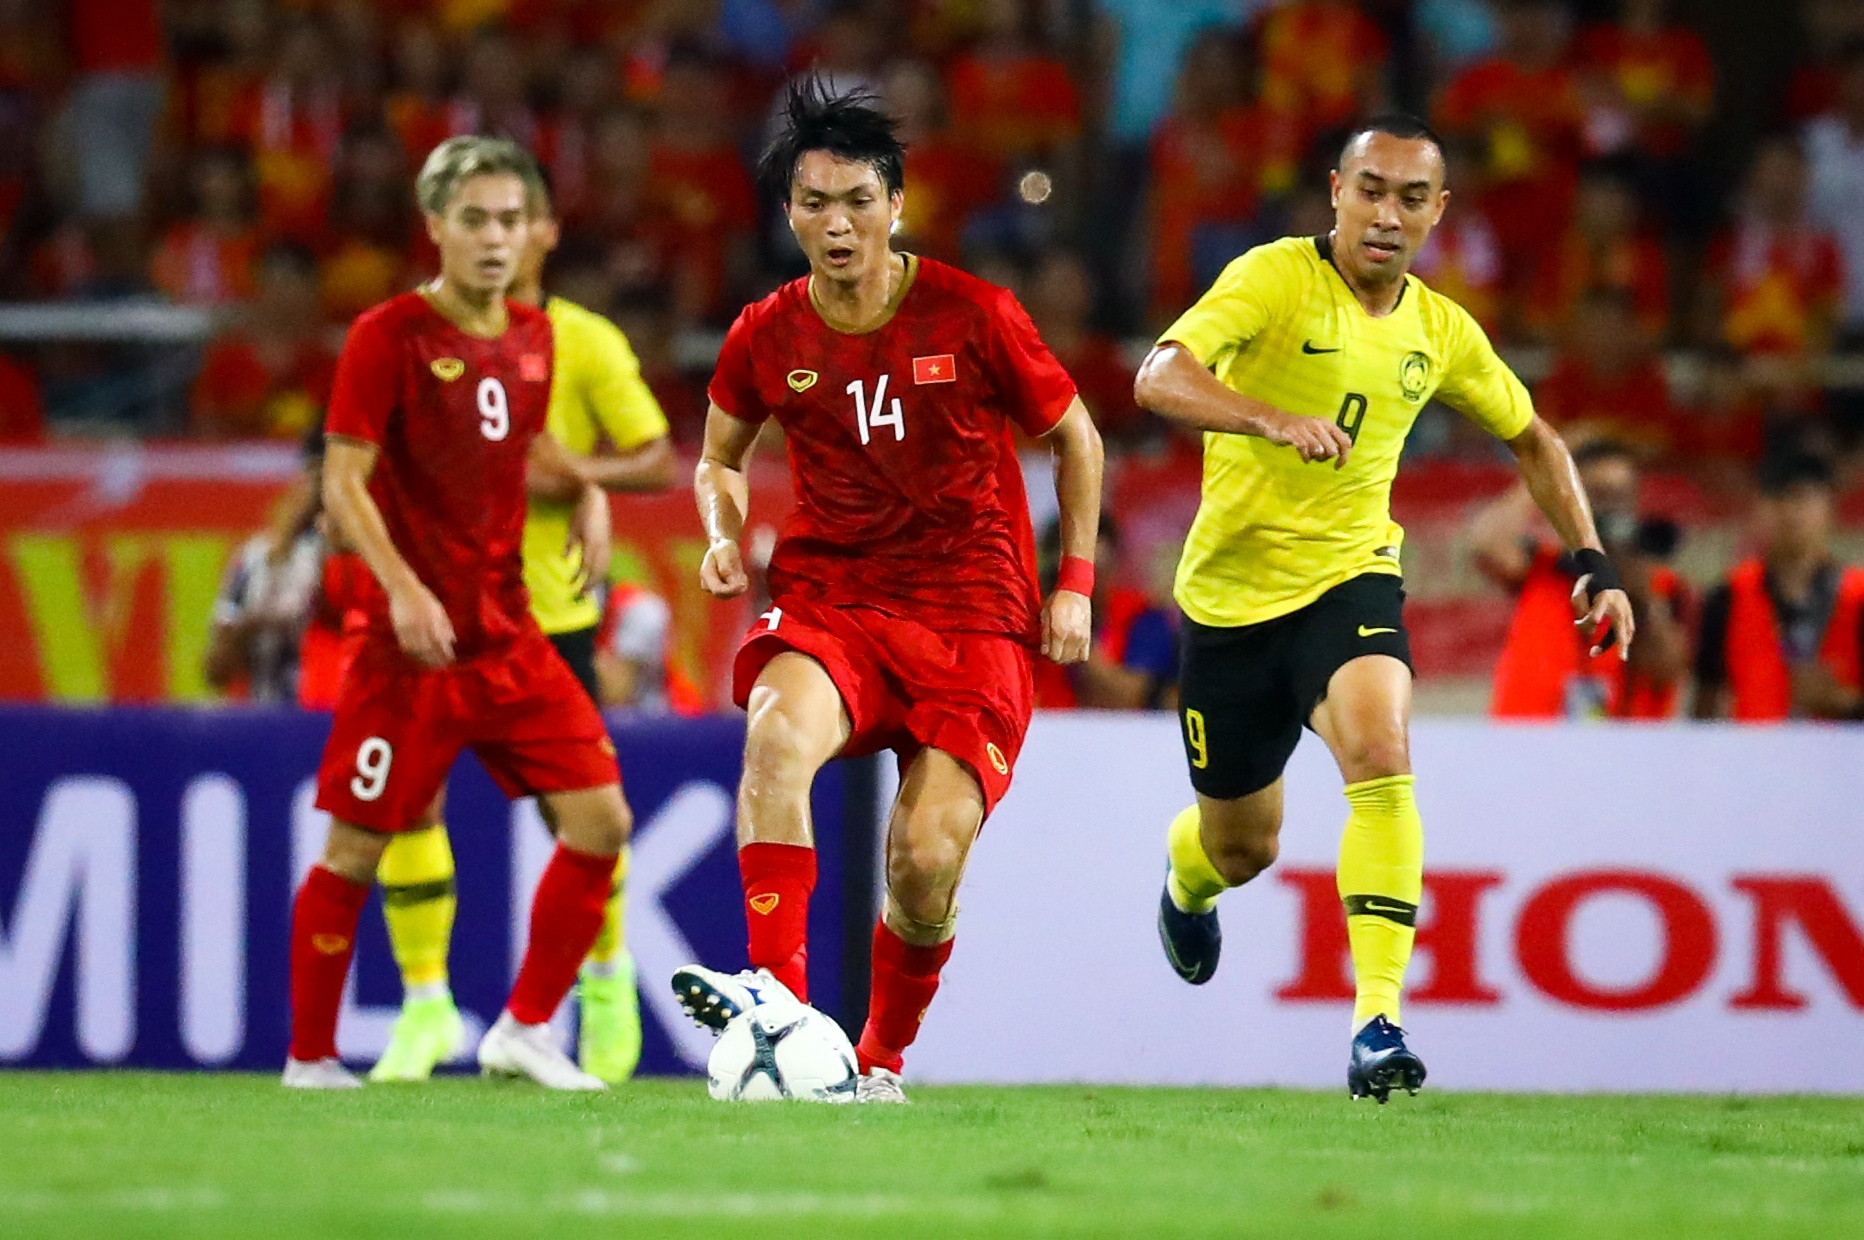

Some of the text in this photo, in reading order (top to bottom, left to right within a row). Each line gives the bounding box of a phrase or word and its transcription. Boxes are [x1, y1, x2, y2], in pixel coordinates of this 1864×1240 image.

[476, 376, 510, 441] 9
[846, 374, 905, 446] 14
[1336, 392, 1368, 448] 9
[350, 736, 393, 801] 9
[1186, 708, 1208, 769] 9
